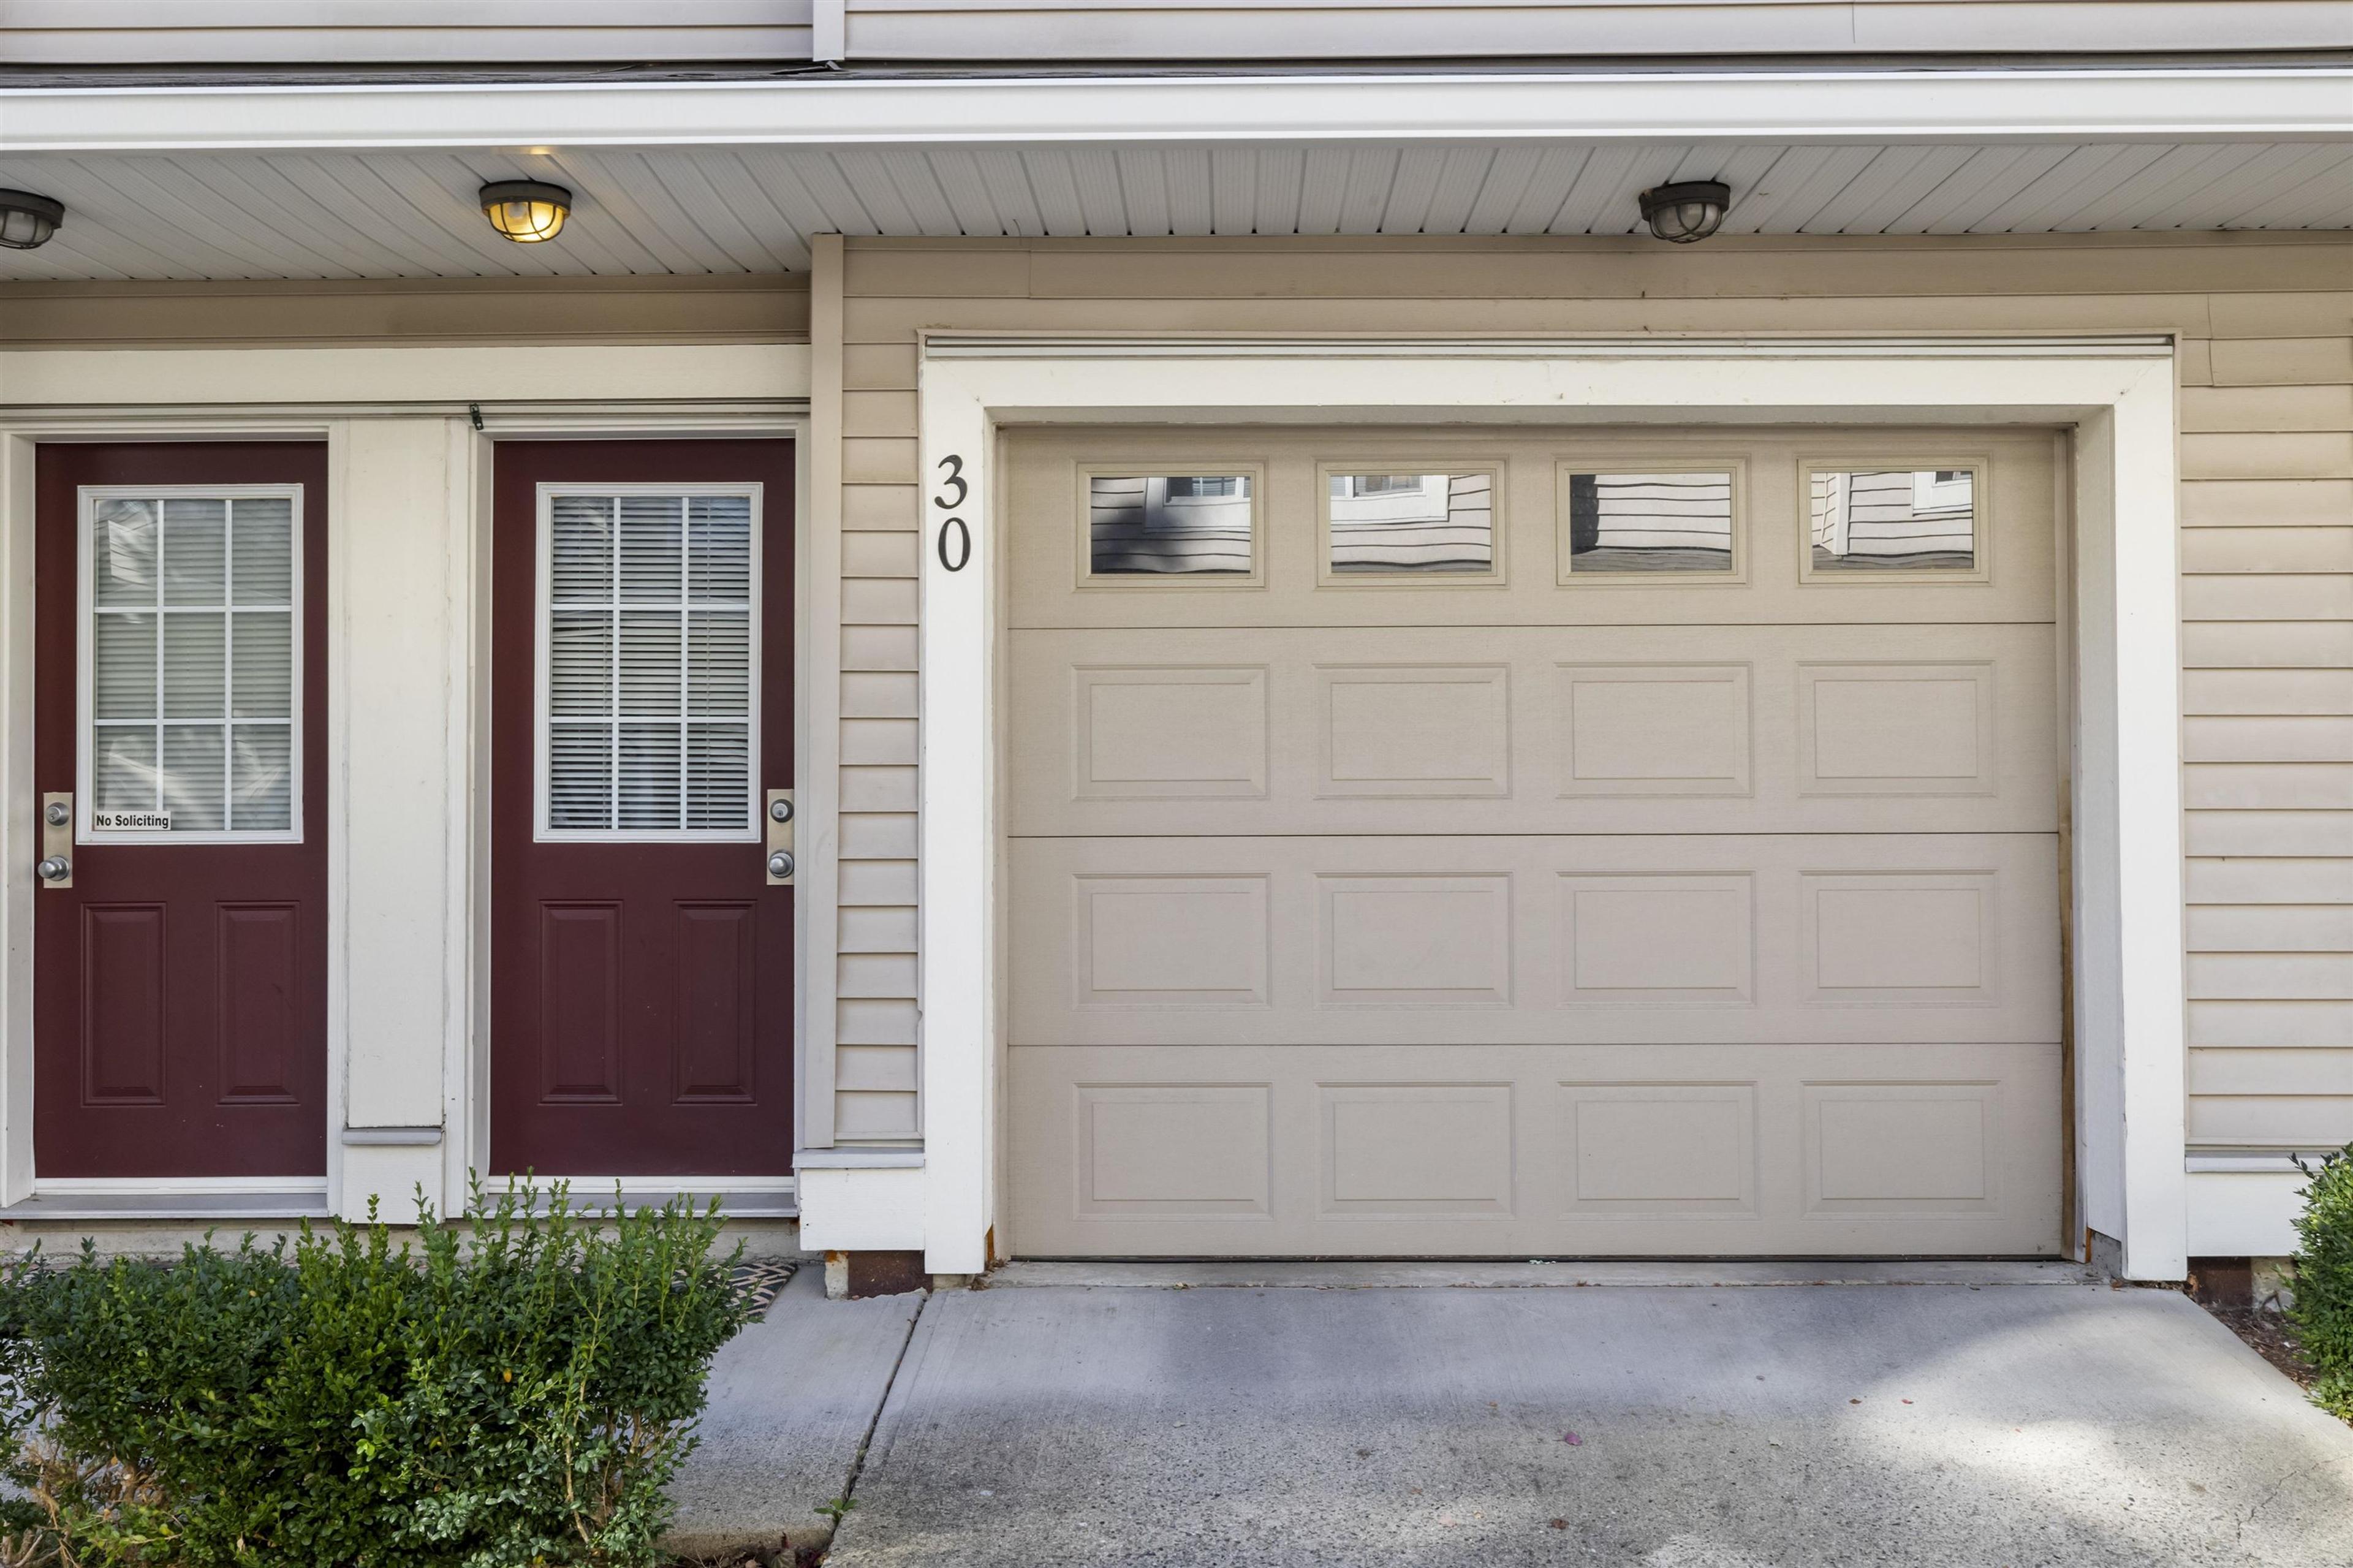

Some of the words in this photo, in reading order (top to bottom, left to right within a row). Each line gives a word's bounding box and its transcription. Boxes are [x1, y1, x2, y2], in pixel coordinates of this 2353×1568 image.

[934, 455, 971, 572] 30
[96, 815, 112, 826] No
[115, 815, 169, 829] Soliciting
